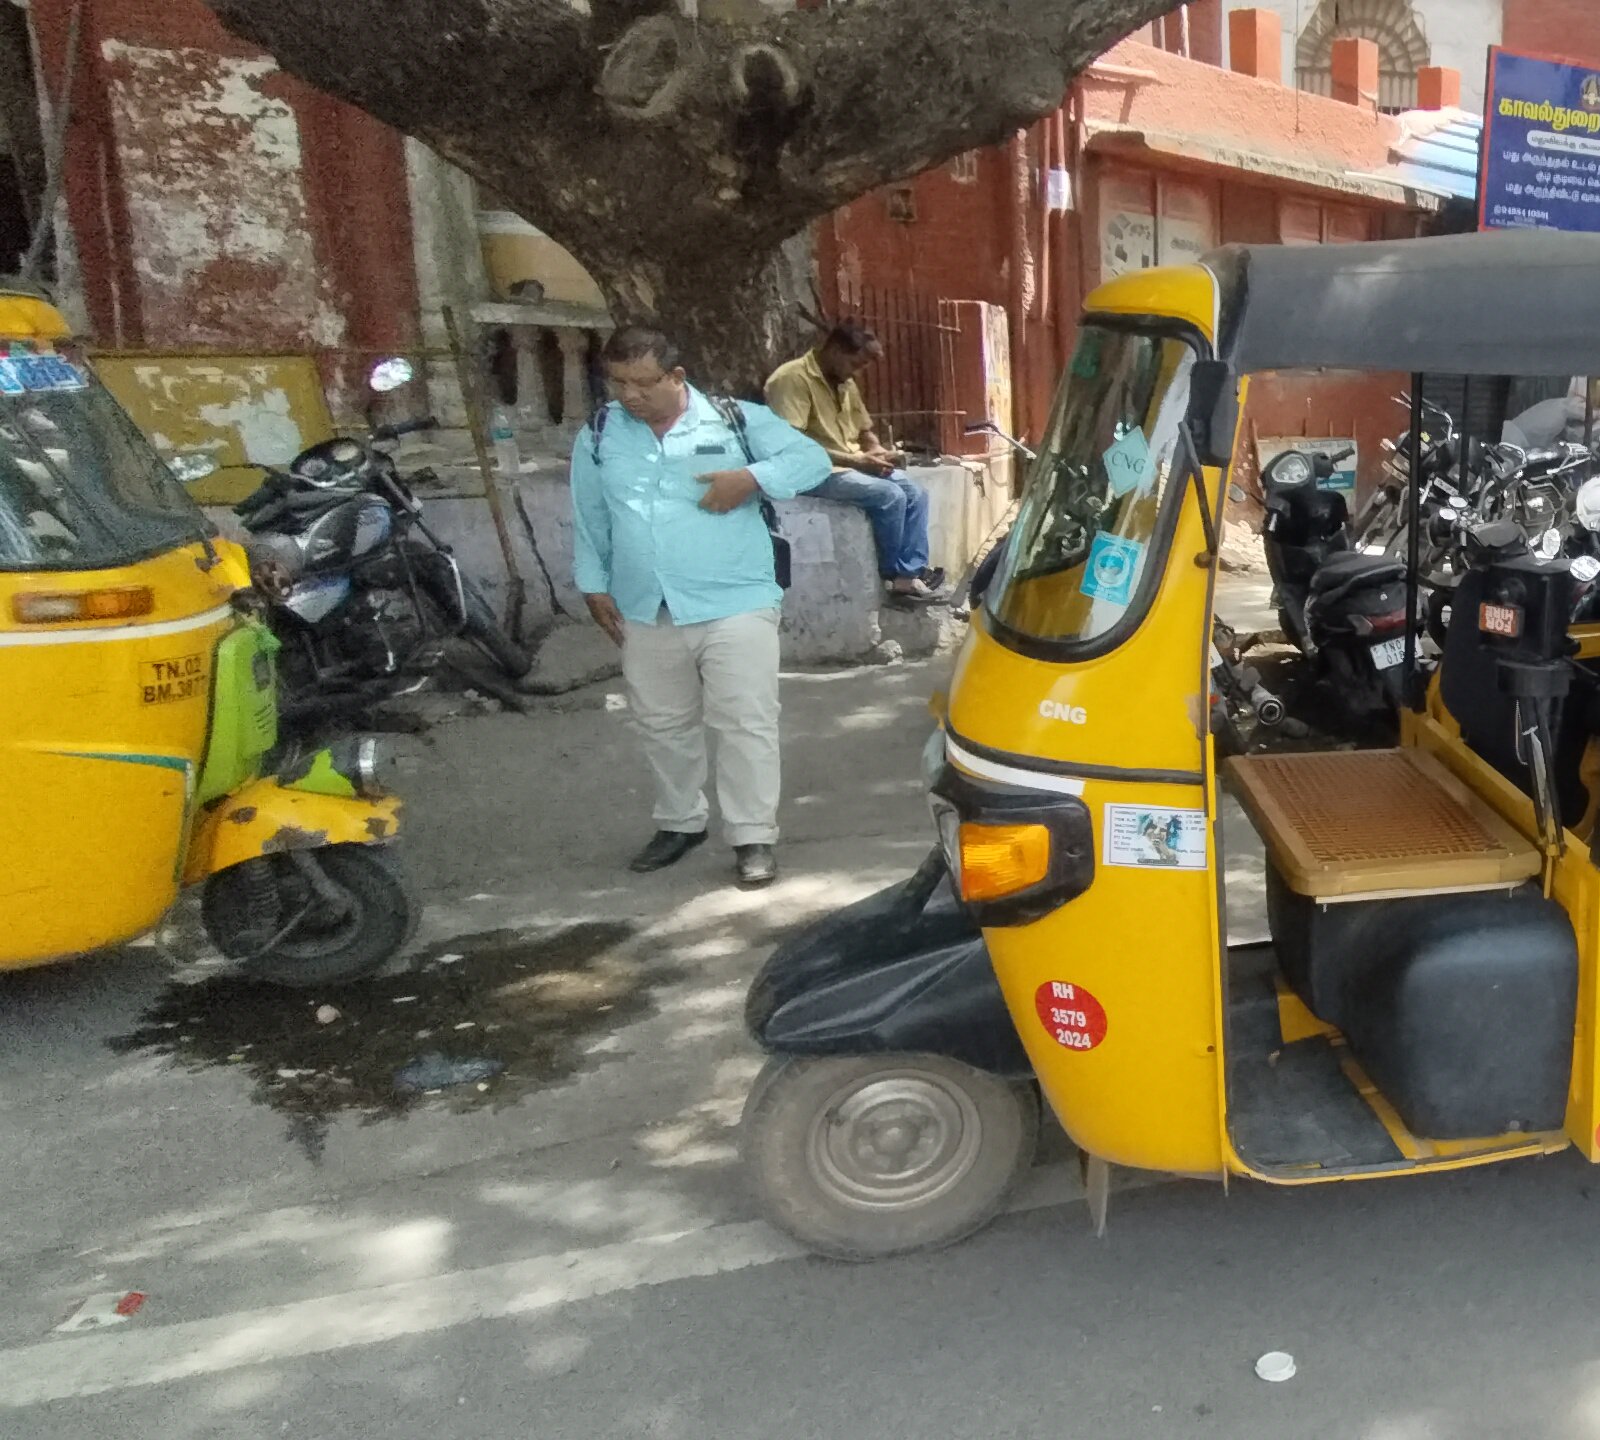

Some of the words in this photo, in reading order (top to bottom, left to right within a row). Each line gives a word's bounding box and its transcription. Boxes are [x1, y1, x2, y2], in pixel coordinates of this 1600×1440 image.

[1499, 98, 1600, 133] காவல்துறை
[1503, 151, 1519, 163] மது
[1506, 182, 1522, 195] மது
[1111, 452, 1147, 475] CNG
[1487, 617, 1512, 633] FOR
[1039, 699, 1088, 725] CNG
[1052, 982, 1075, 1000] RH
[1051, 1007, 1087, 1028] 3579
[1056, 1028, 1092, 1049] 2024
